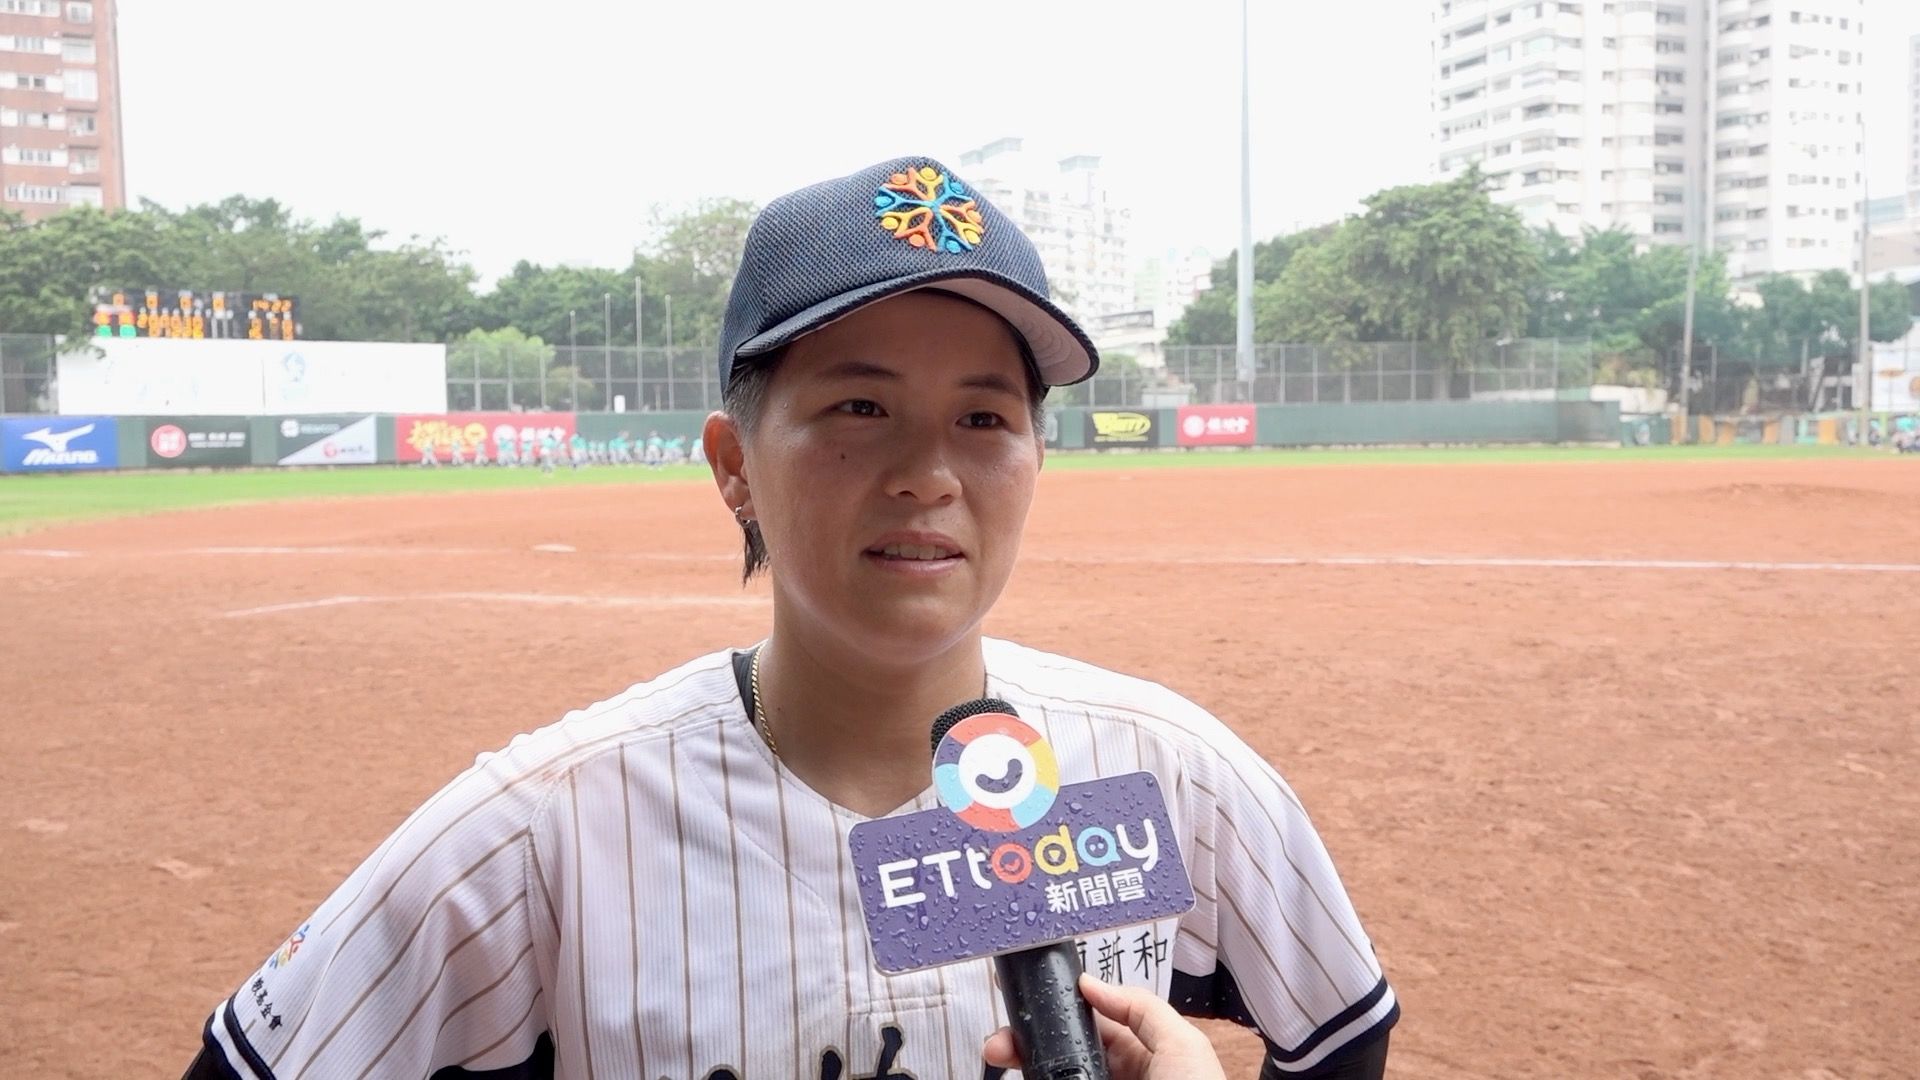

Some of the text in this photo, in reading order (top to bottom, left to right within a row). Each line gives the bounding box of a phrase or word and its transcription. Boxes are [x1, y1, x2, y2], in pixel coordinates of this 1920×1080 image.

[877, 818, 1160, 909] ETtoday
[1044, 867, 1147, 914] 新聞雲
